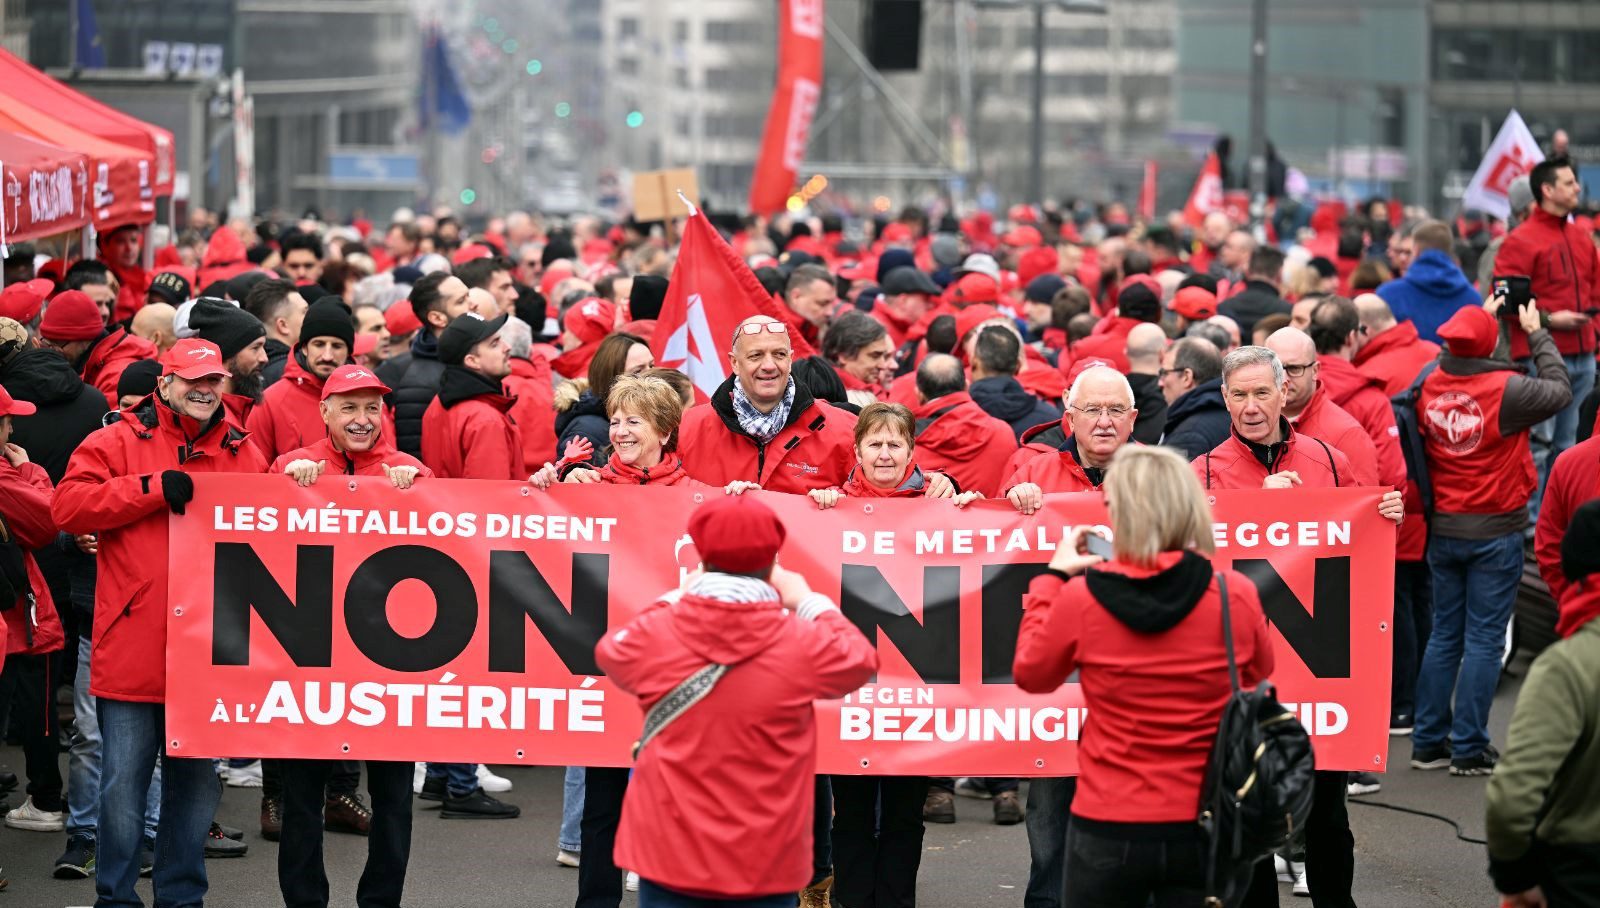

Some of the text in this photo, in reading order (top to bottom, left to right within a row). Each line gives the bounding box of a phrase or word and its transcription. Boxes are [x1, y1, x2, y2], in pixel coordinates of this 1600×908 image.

[214, 502, 617, 542] LES MÉTALLOS DISENT
[842, 521, 1350, 555] DE METAL EGGEN
[211, 542, 610, 677] NON
[210, 698, 230, 723] À
